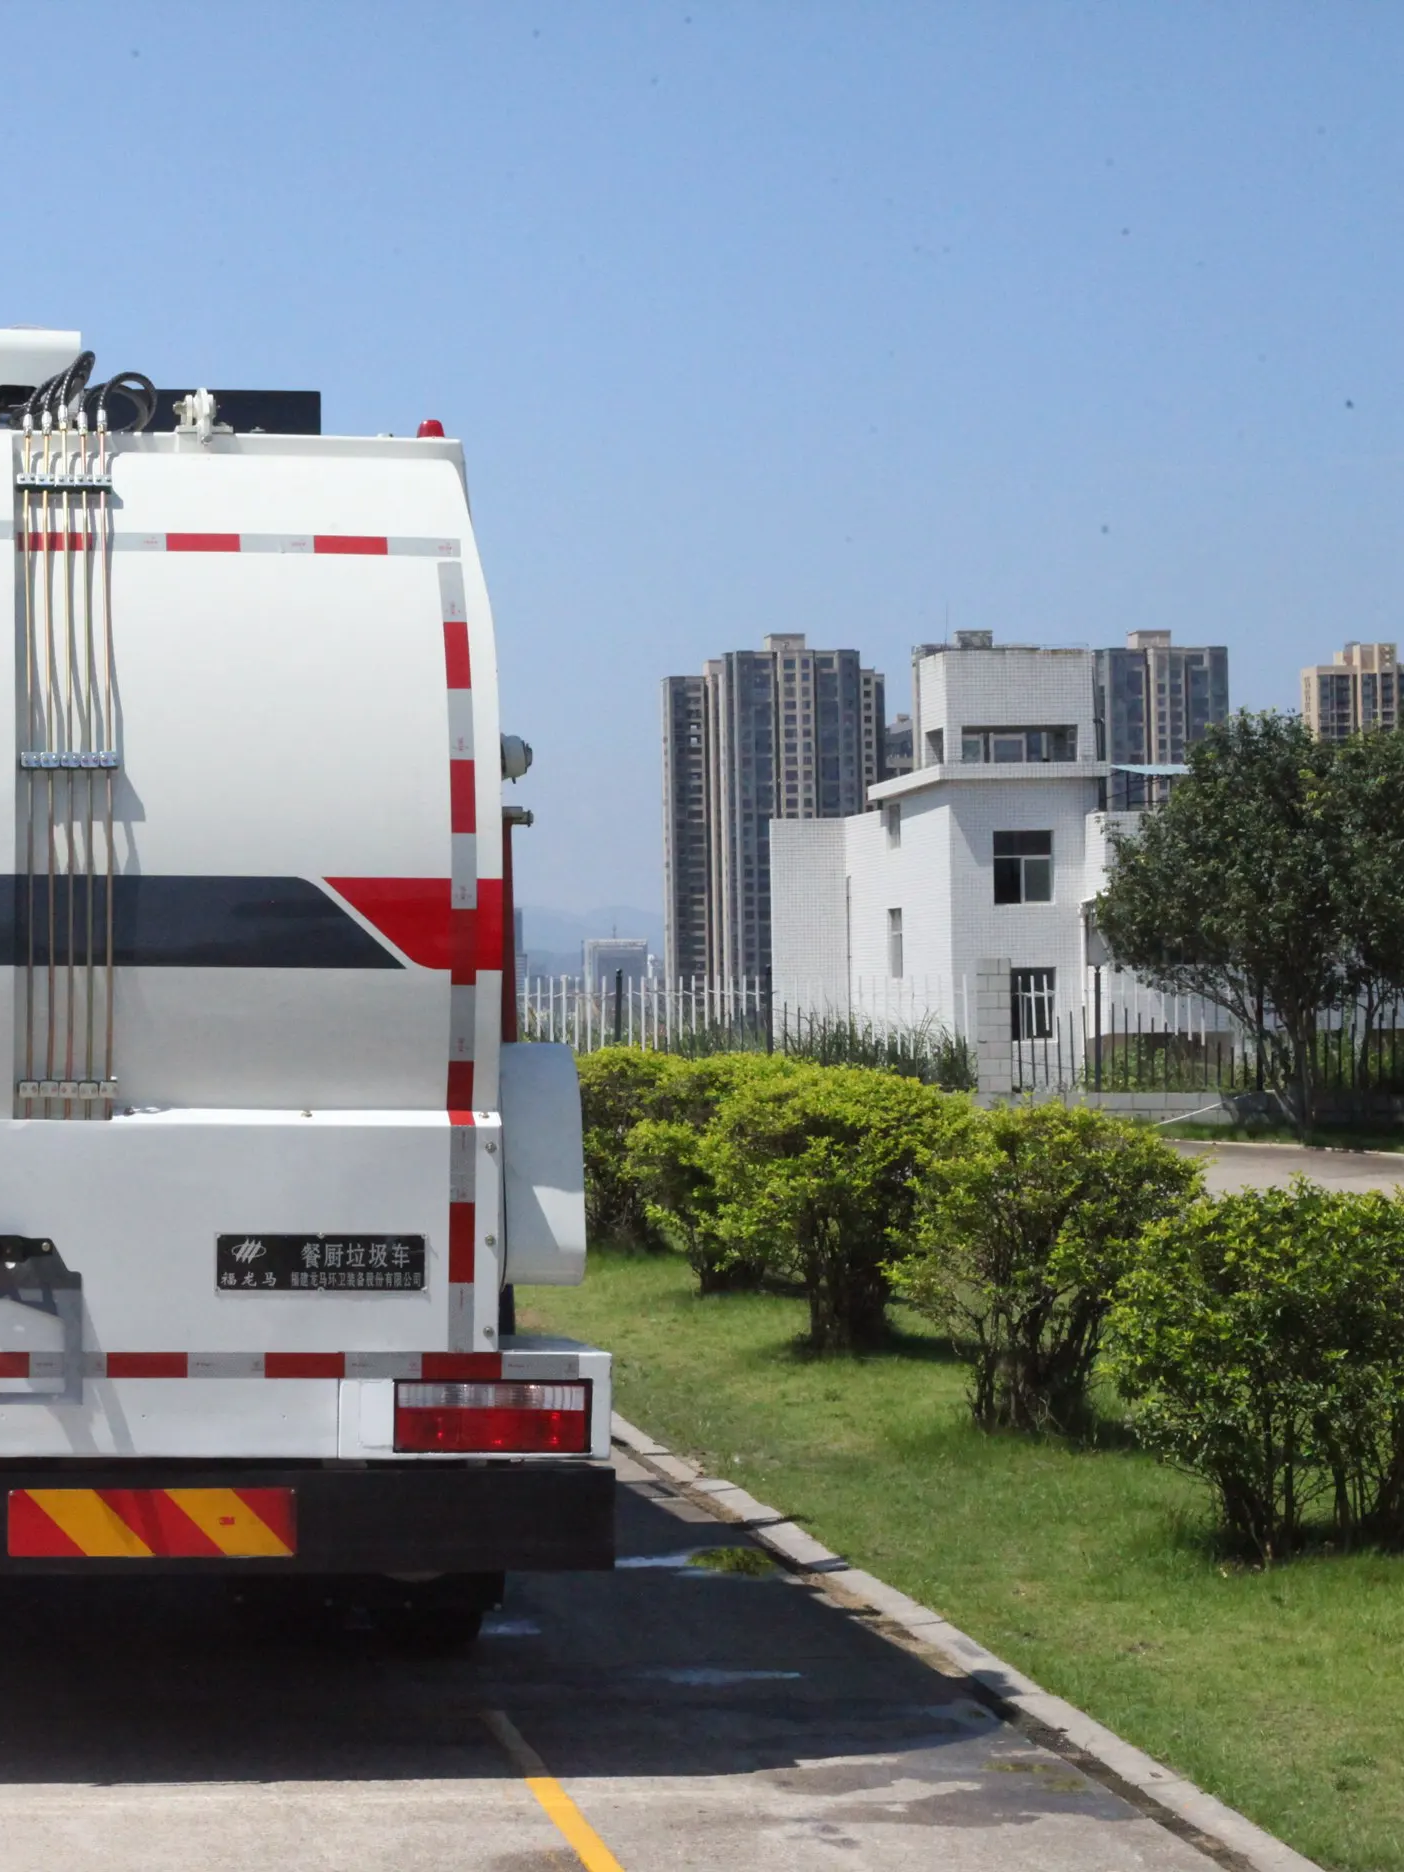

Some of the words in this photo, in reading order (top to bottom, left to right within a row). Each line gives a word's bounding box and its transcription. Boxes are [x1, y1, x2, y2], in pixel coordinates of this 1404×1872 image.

[301, 1242, 410, 1268] 餐厨垃圾车
[220, 1271, 277, 1287] 福龙马
[219, 1516, 235, 1526] 3M
